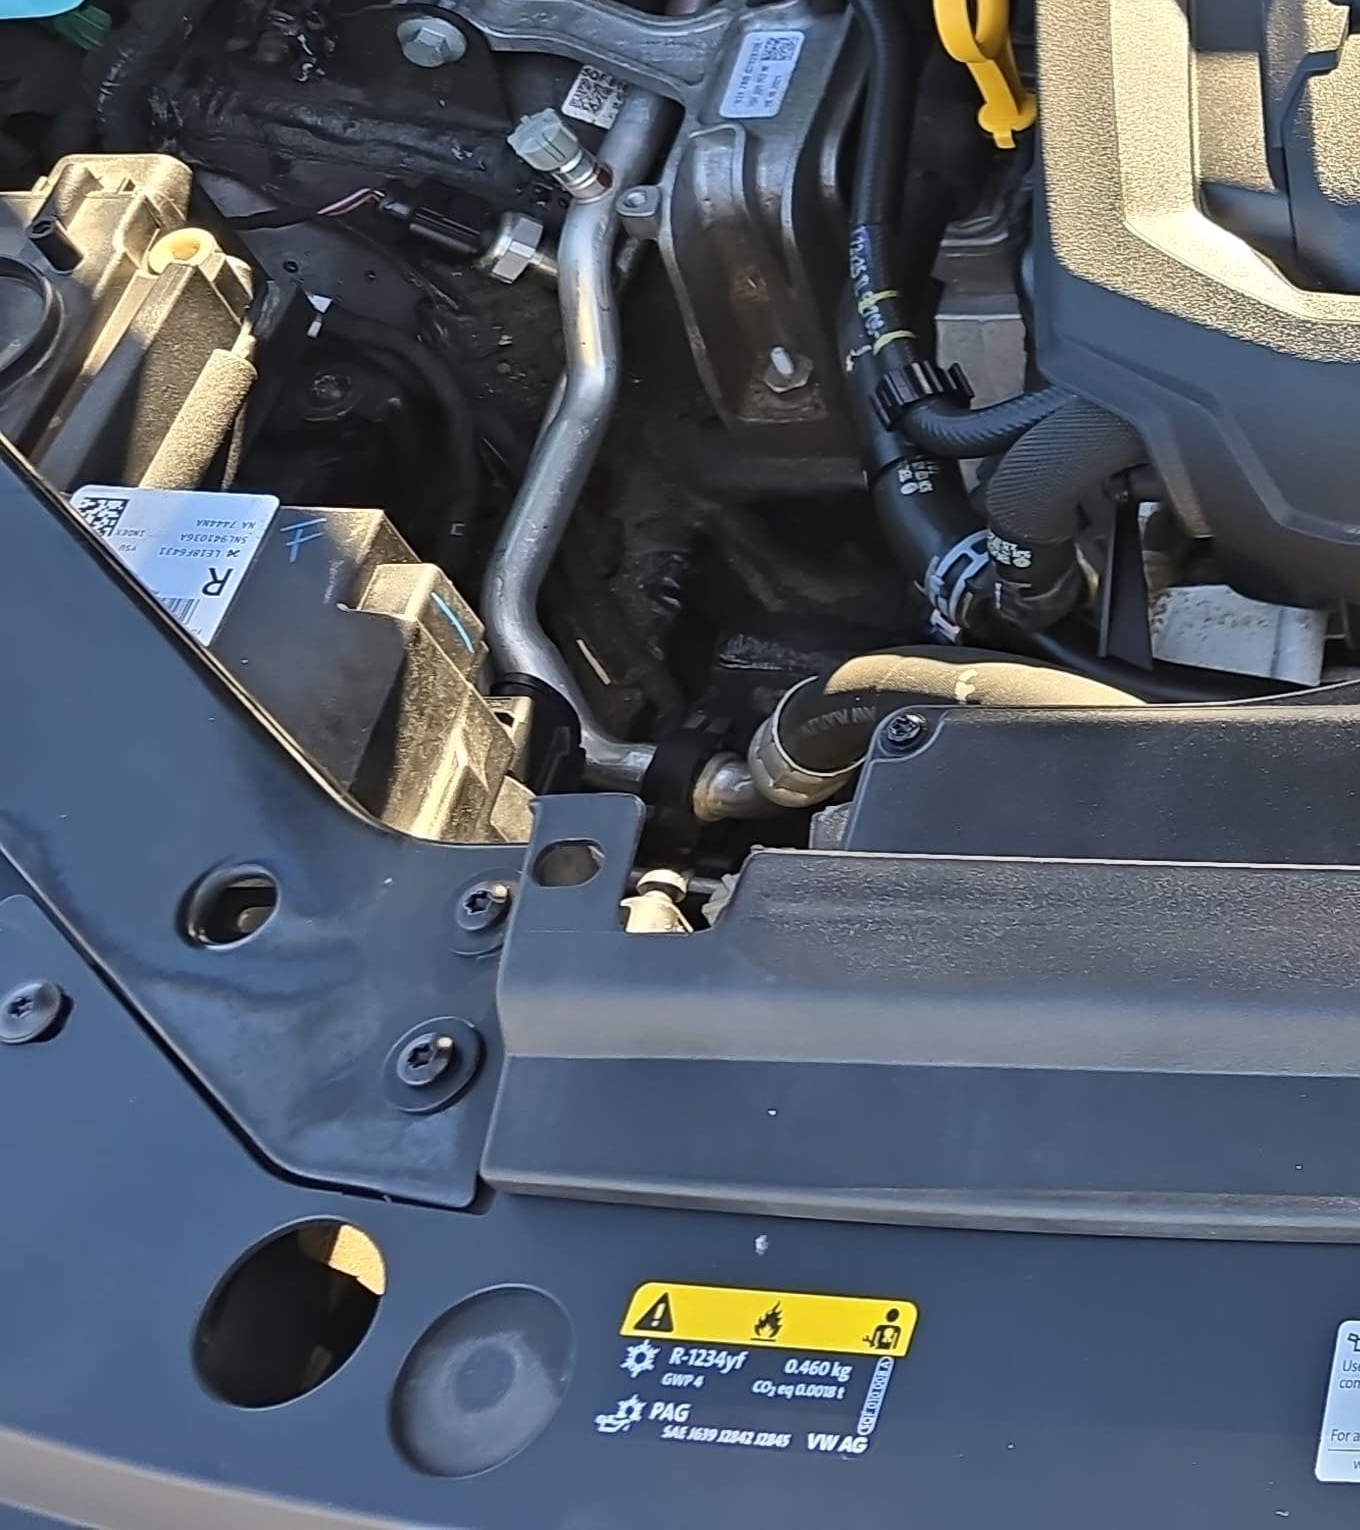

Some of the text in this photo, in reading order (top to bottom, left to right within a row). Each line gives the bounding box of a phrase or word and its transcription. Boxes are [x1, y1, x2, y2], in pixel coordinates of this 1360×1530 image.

[201, 567, 234, 597] R
[668, 1346, 852, 1382] R-1234yf 0.460 kg
[661, 1373, 695, 1387] GWP
[695, 1375, 704, 1388] 4
[778, 1384, 795, 1399] eq
[836, 1386, 846, 1399] t
[649, 1401, 691, 1422] PAG
[661, 1425, 688, 1439] SAE
[807, 1433, 840, 1451] VW
[838, 1436, 869, 1454] AG
[1330, 1429, 1351, 1442] For
[1352, 1431, 1360, 1442] a
